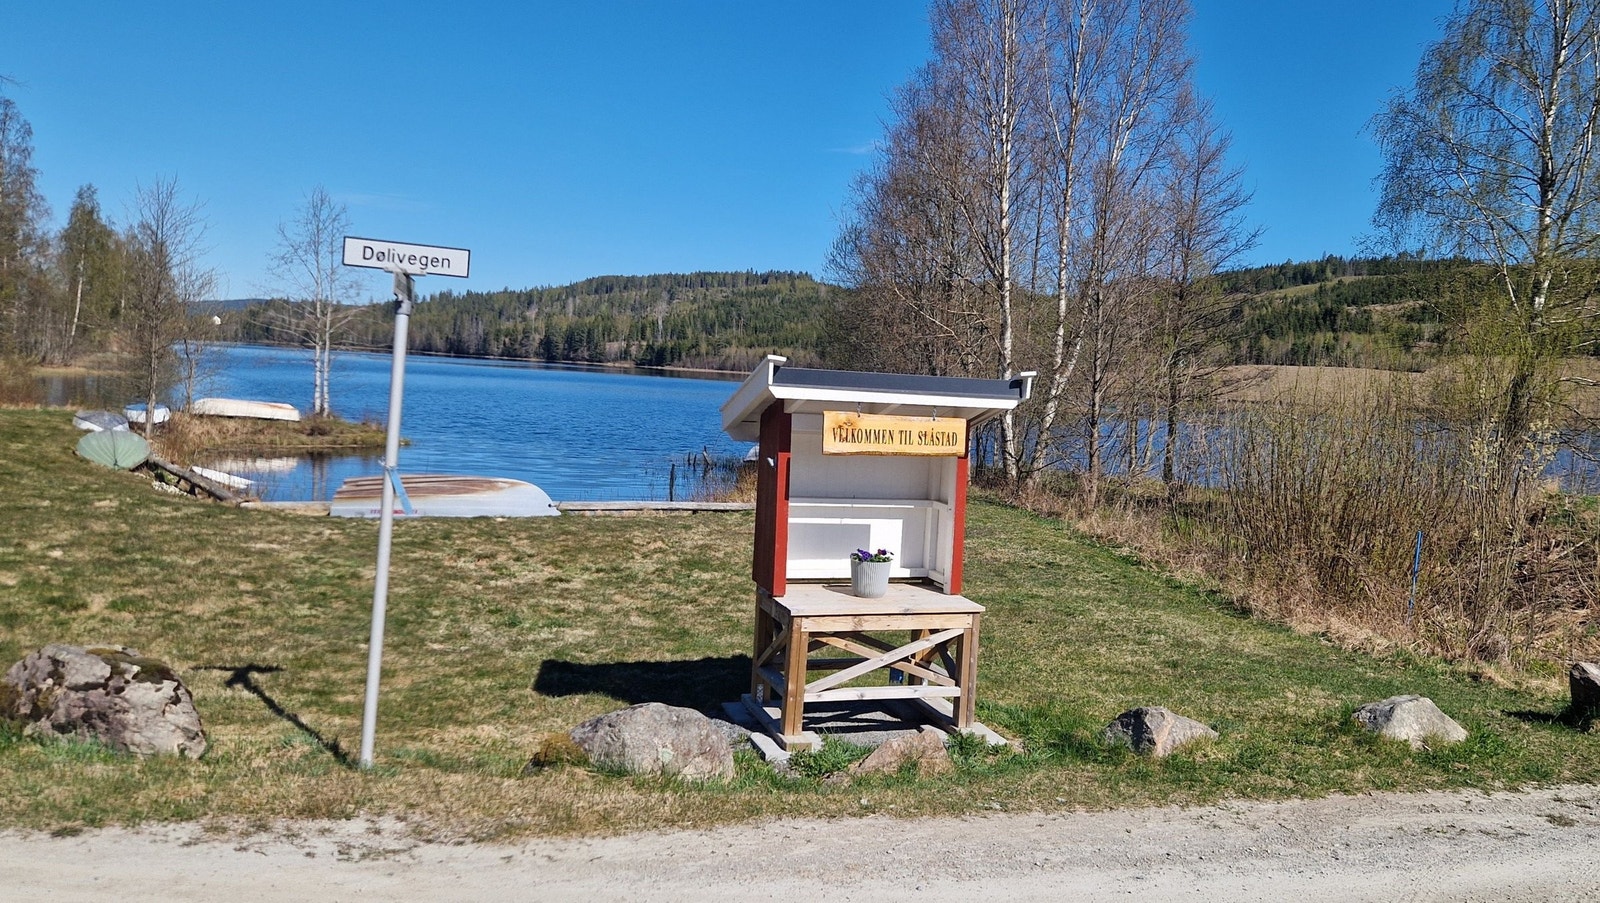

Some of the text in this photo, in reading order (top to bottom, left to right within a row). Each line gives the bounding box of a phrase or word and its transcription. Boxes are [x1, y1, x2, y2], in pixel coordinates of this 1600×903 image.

[362, 245, 451, 270] Dølivegen
[832, 427, 958, 447] VELKOMMEN TIL SLÅSTAD
